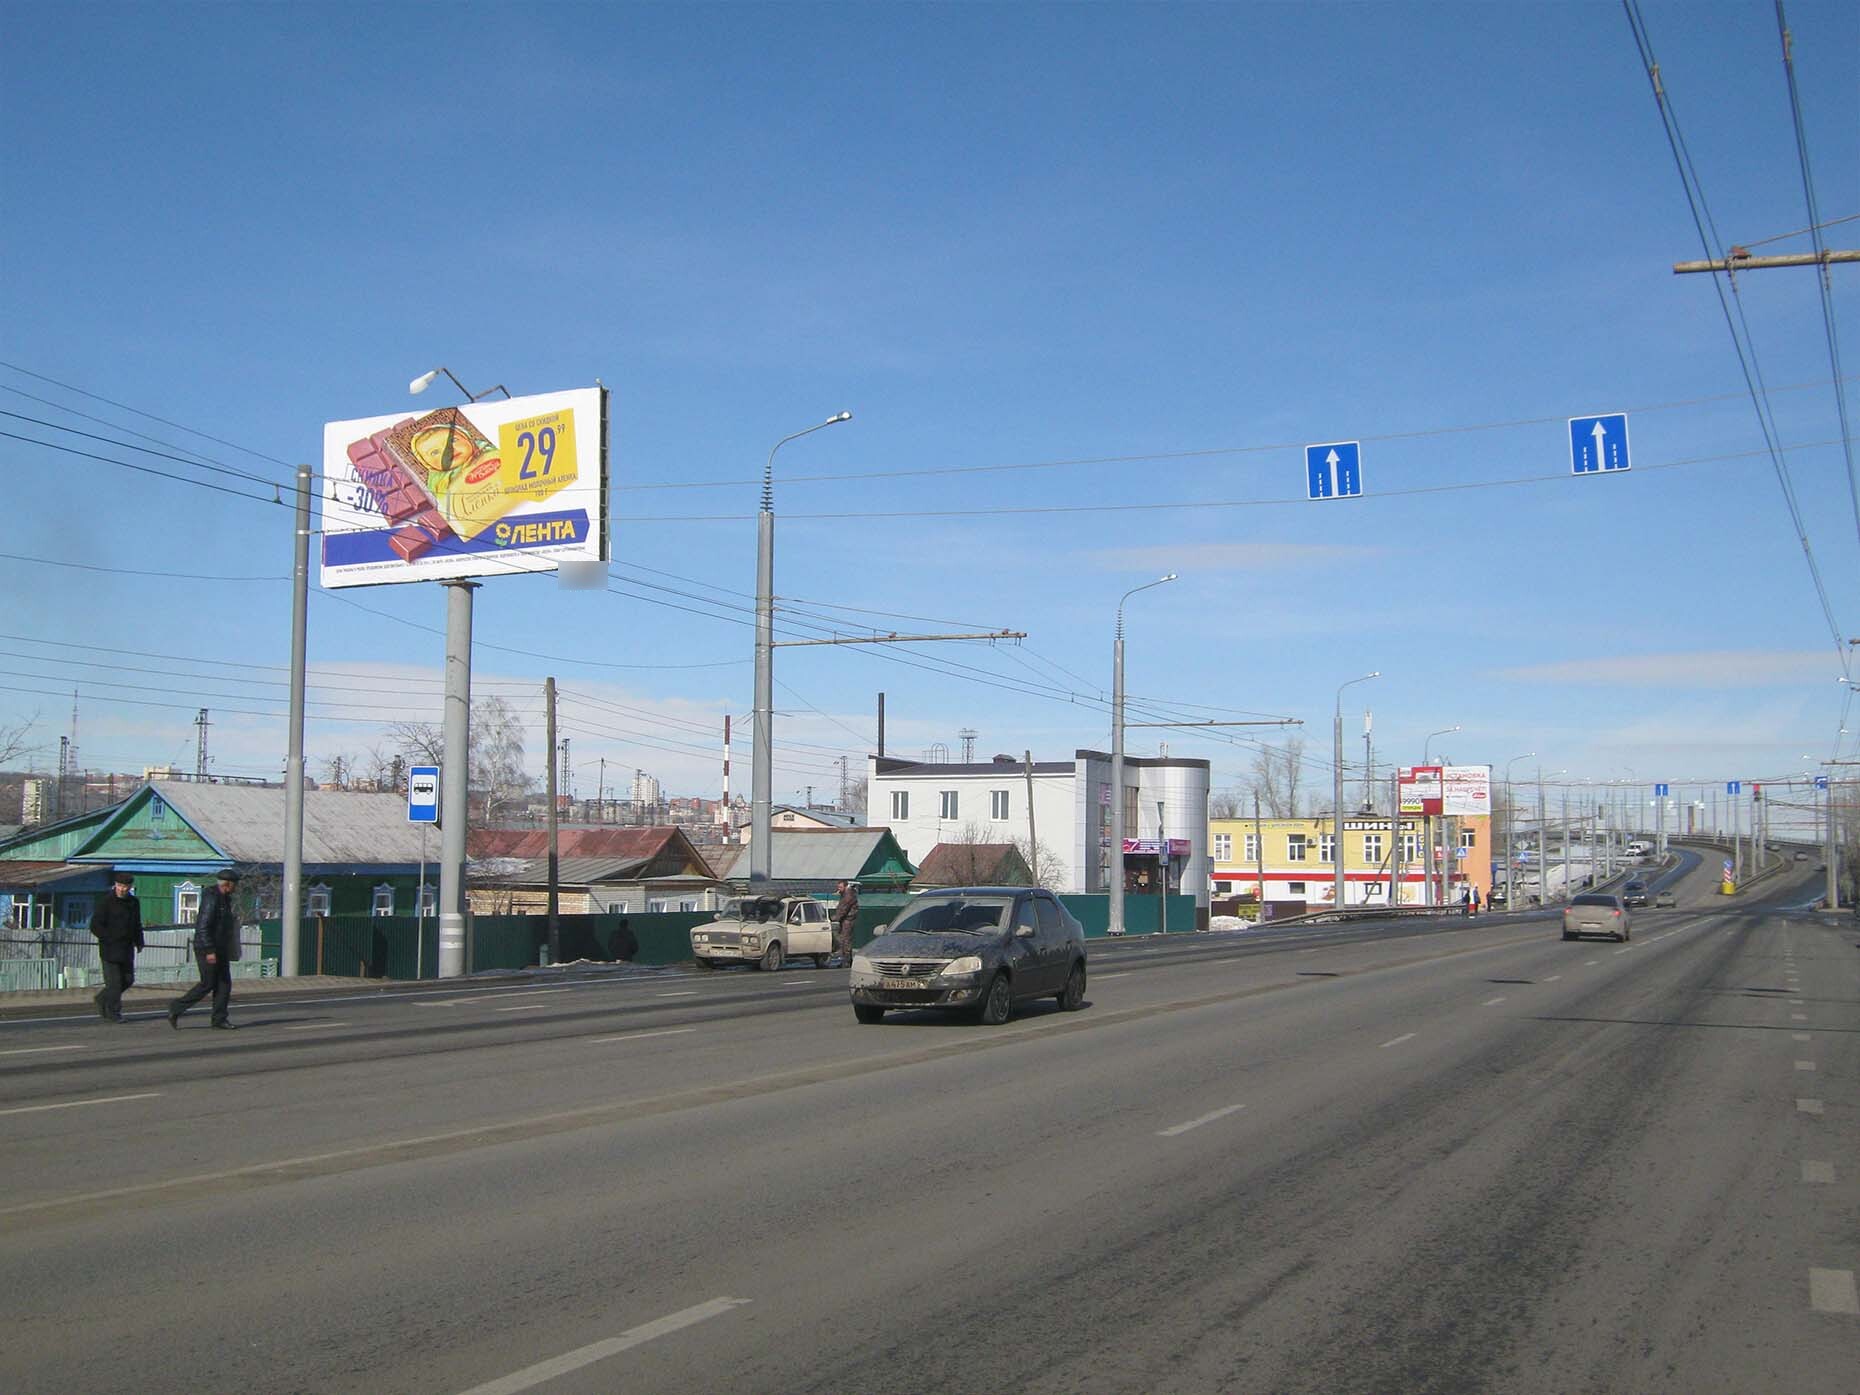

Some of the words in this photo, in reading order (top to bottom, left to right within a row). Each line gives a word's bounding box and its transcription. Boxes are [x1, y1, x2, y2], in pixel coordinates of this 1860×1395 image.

[517, 426, 556, 480] 29
[346, 485, 389, 514] -30%
[510, 520, 576, 545] ЛЕНТА
